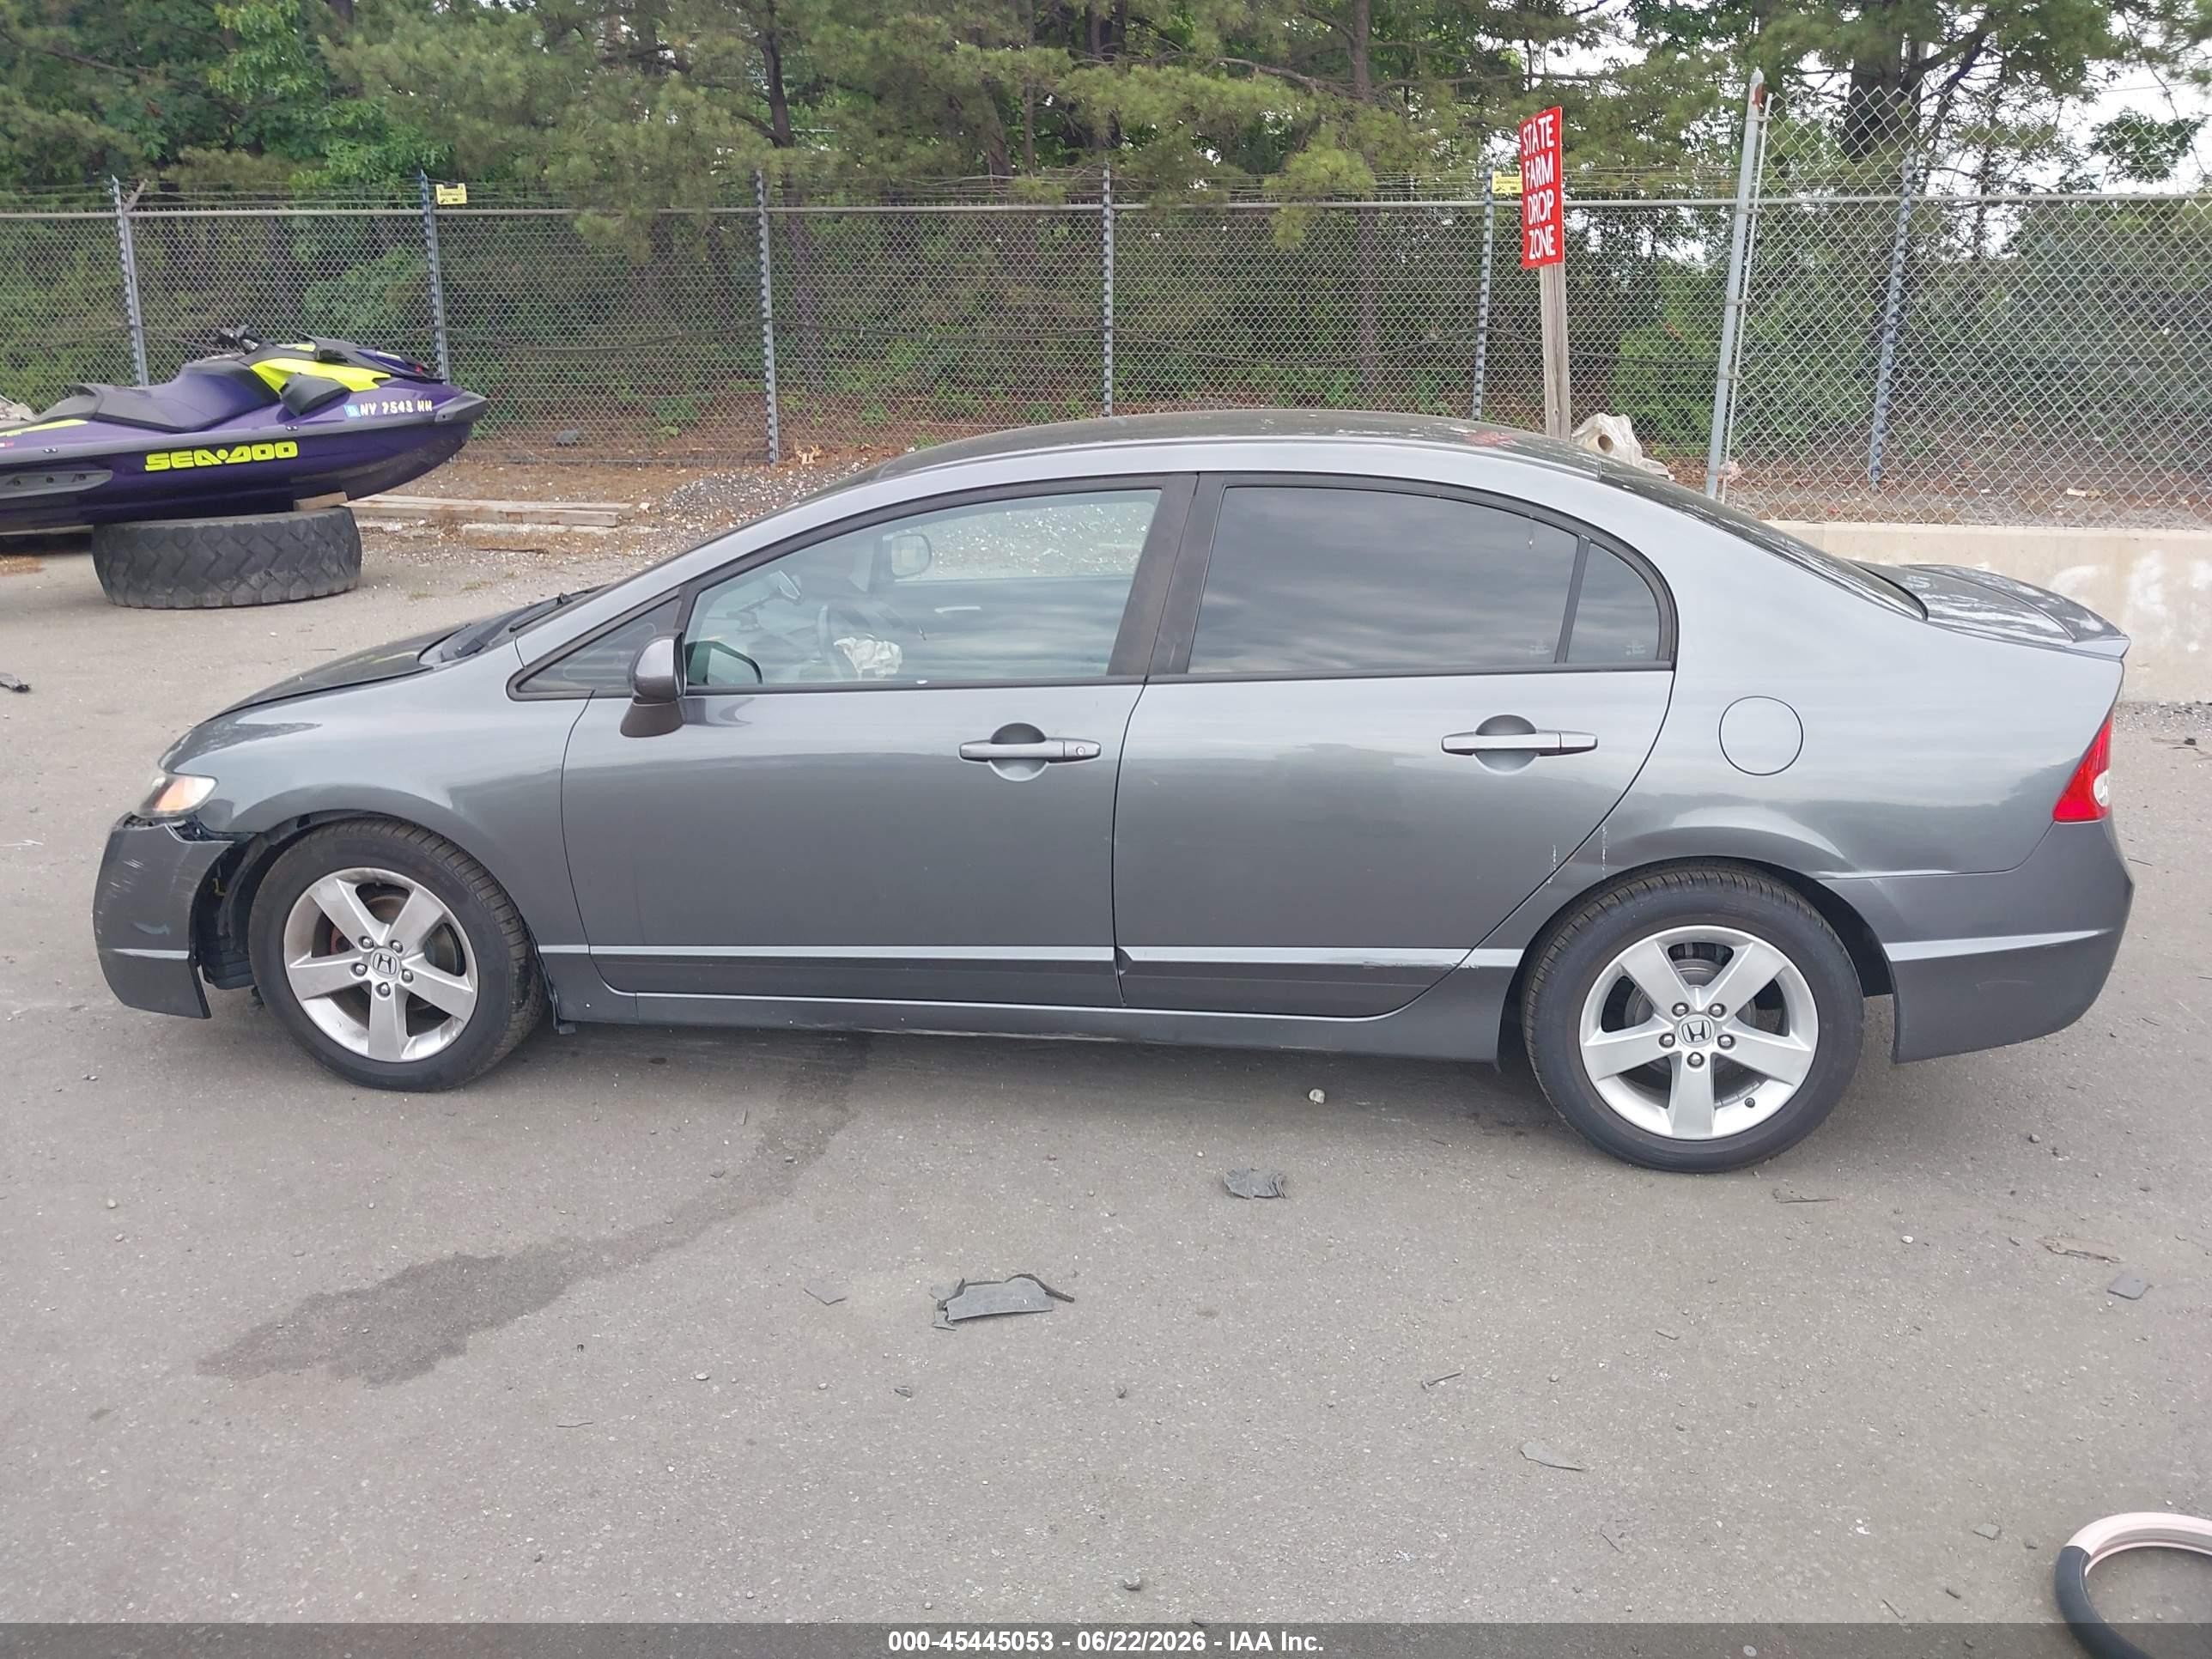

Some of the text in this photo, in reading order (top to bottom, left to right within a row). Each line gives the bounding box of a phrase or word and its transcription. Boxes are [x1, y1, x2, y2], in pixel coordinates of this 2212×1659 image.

[1522, 114, 1555, 157] STATE
[1525, 151, 1554, 191] FARM
[1527, 189, 1555, 226] DROP
[1528, 224, 1556, 260] ZONE
